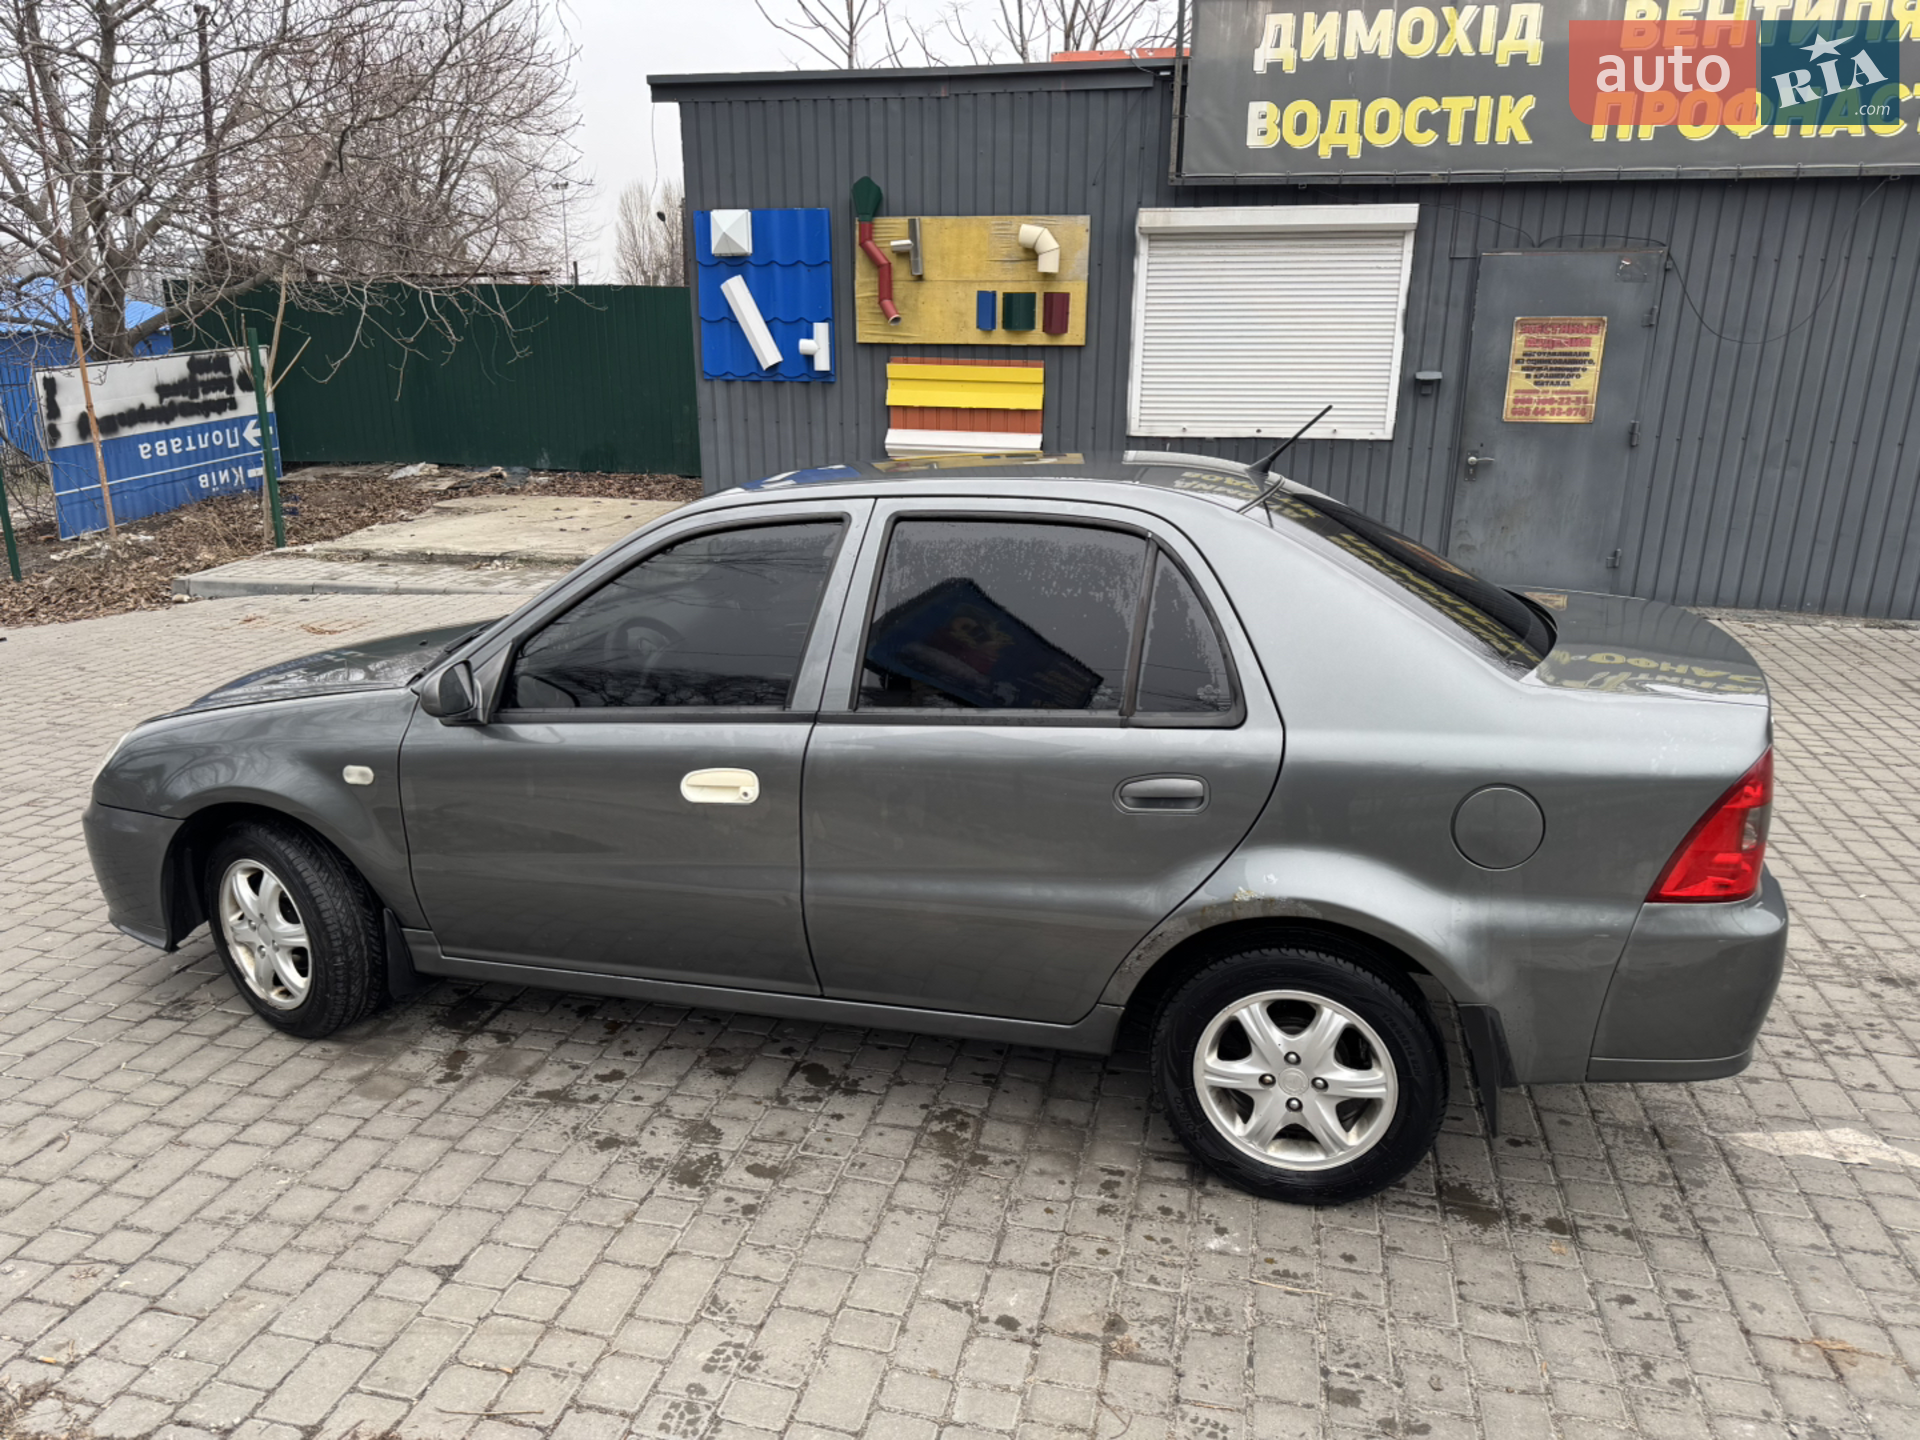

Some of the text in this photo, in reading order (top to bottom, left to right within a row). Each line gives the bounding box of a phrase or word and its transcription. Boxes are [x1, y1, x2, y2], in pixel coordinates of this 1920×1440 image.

[1253, 3, 1544, 73] ДИМОХІД
[1246, 94, 1537, 158] ВОДОСТІК
[138, 427, 240, 460] Полтава
[198, 465, 245, 492] Київ
